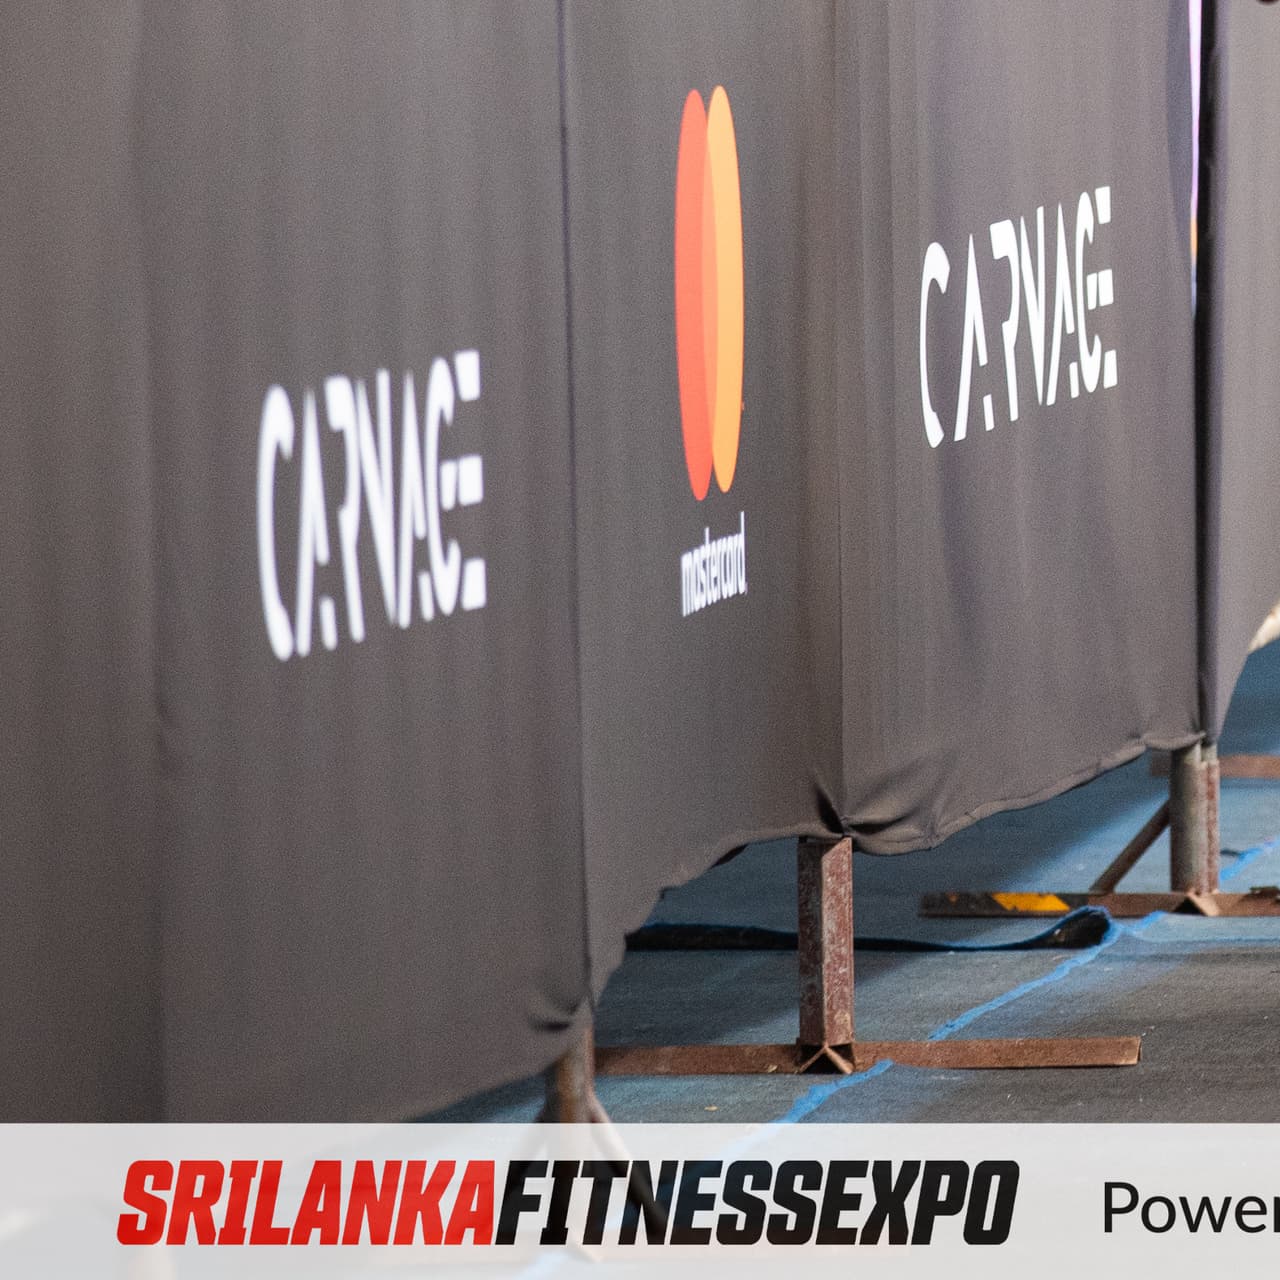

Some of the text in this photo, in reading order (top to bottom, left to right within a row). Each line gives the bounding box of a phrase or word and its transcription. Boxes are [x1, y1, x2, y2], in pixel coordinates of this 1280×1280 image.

[920, 186, 1118, 448] CARNAGE
[257, 349, 487, 660] CARNAGE
[681, 511, 747, 616] mastercard
